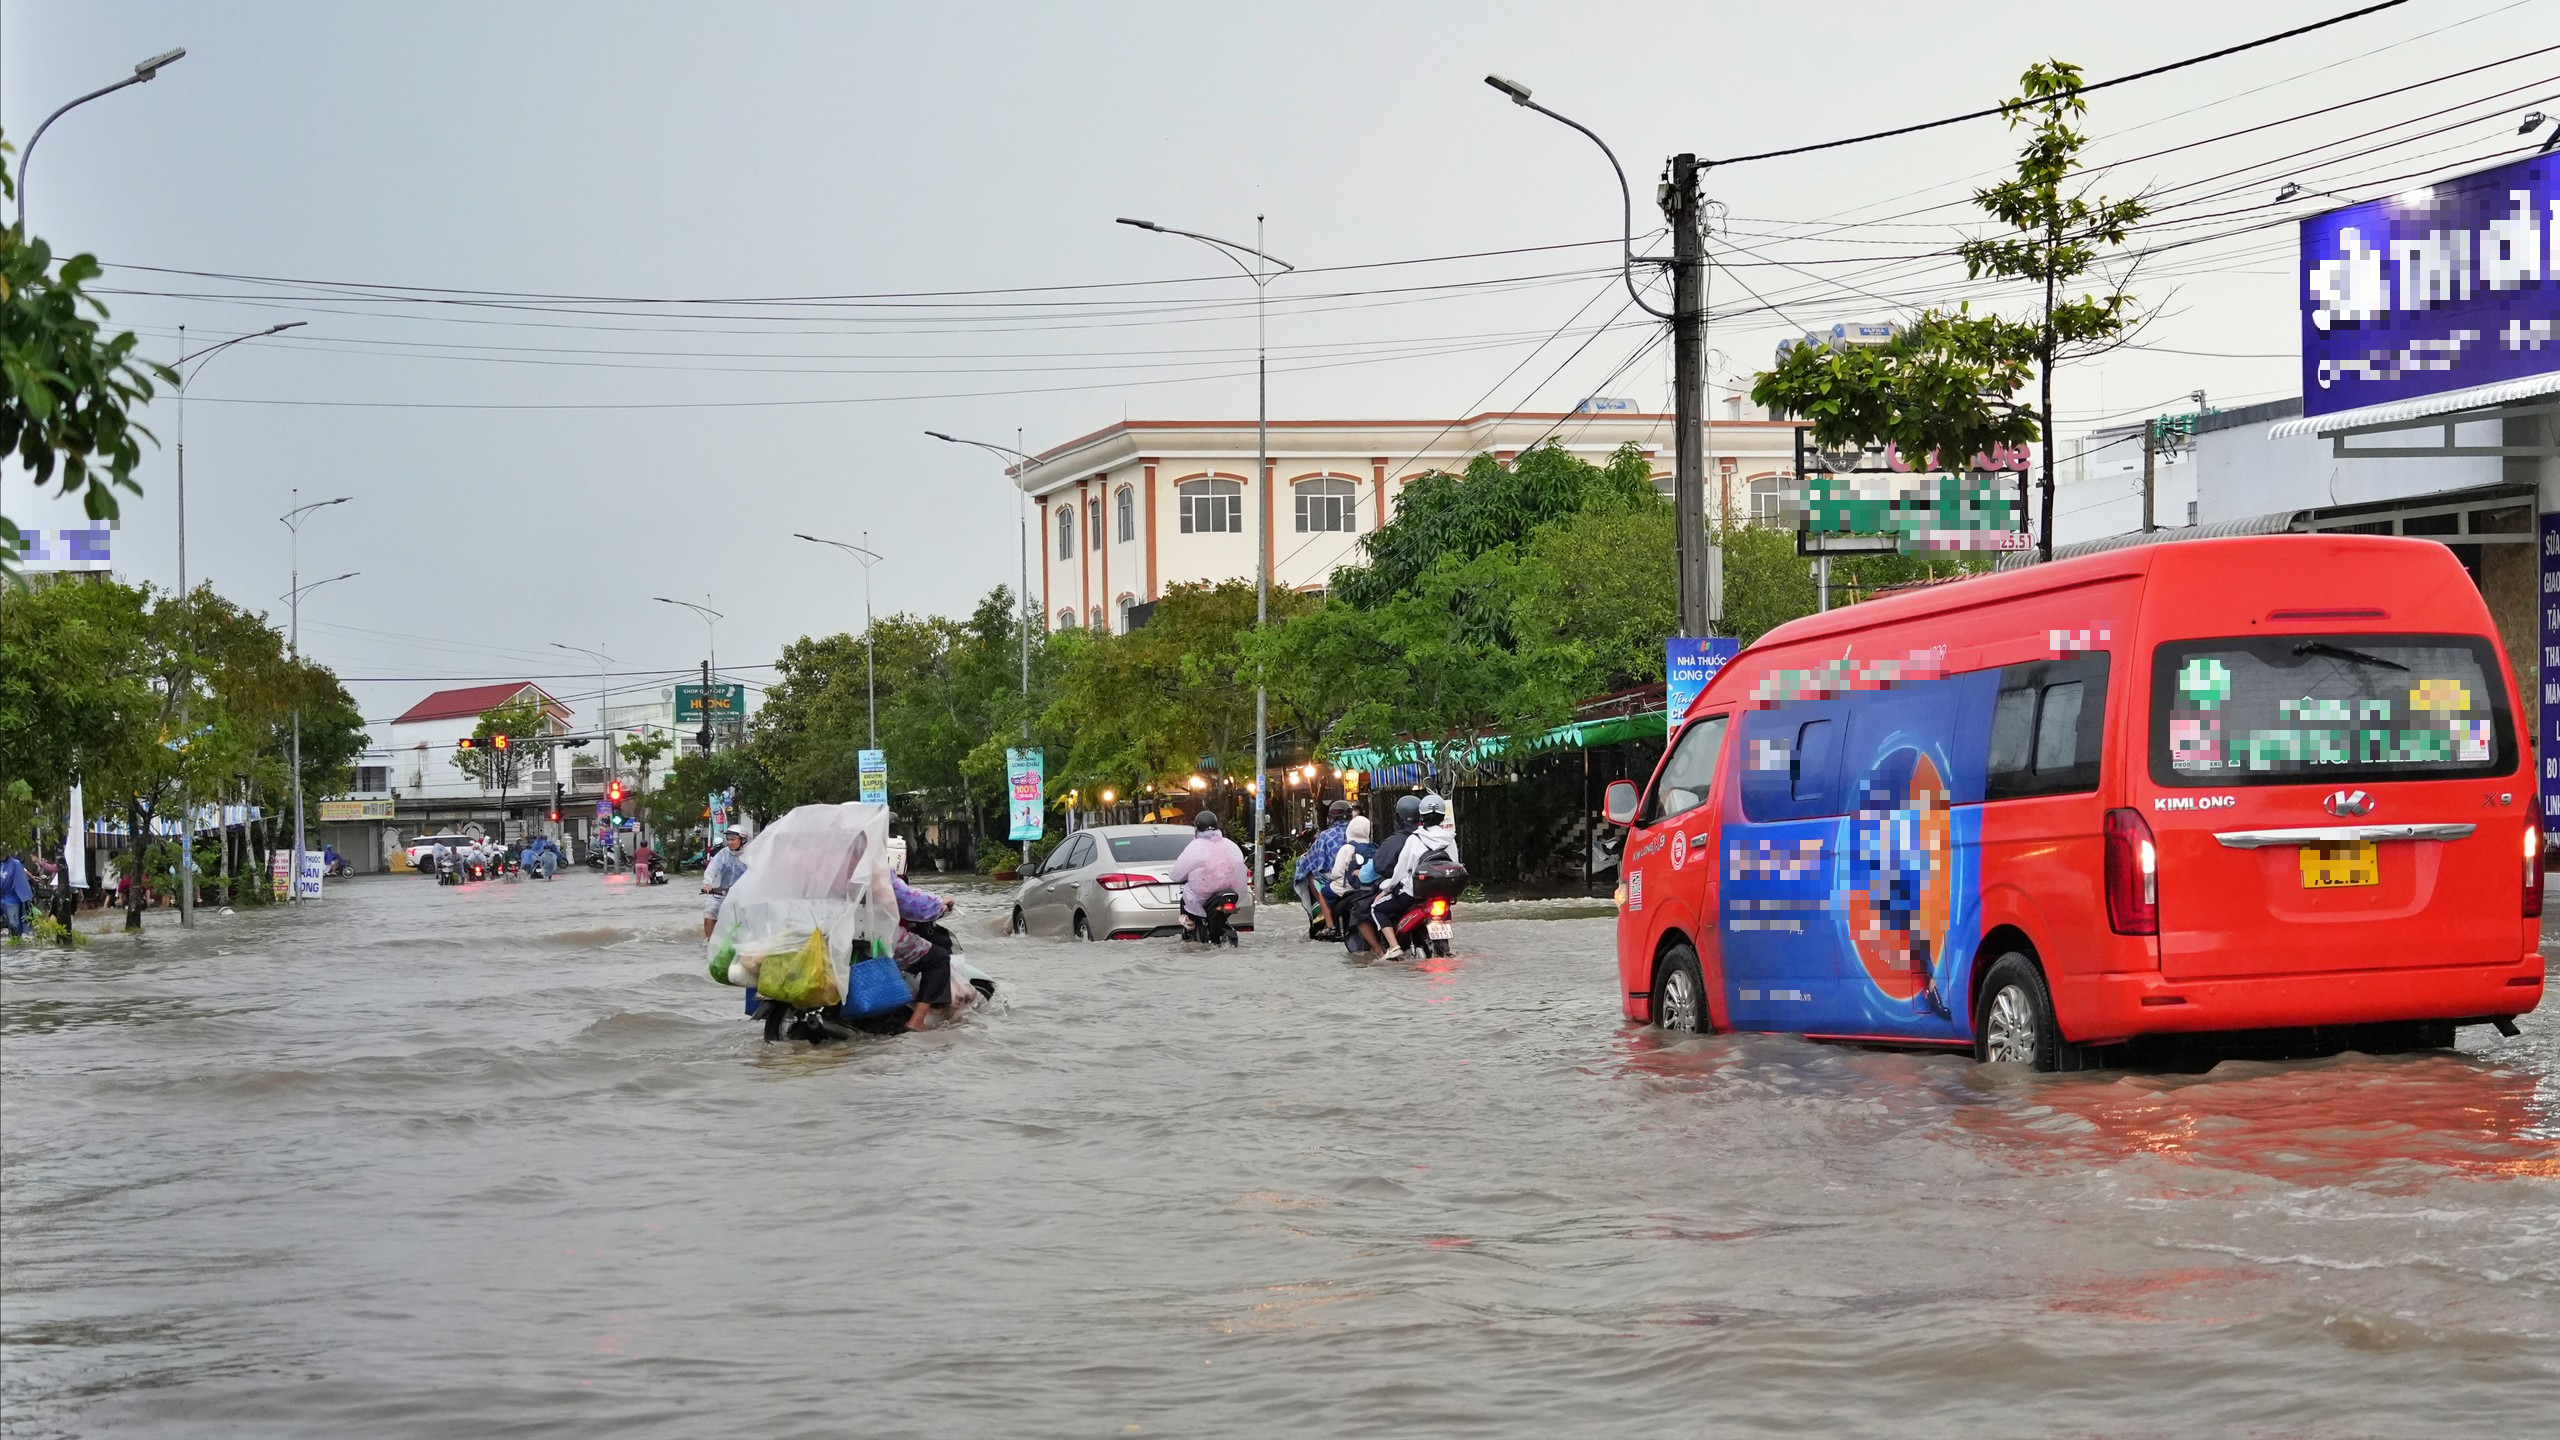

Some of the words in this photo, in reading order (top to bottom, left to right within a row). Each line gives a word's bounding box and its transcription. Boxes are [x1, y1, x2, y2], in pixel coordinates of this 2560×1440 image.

[1677, 654, 1696, 666] NHÀ
[1698, 653, 1727, 666] THUỐC
[2545, 646, 2560, 667] THA
[1673, 669, 1703, 681] LONG
[495, 736, 506, 748] 16
[1016, 785, 1037, 794] 100%
[2154, 795, 2236, 811] KIMLONG
